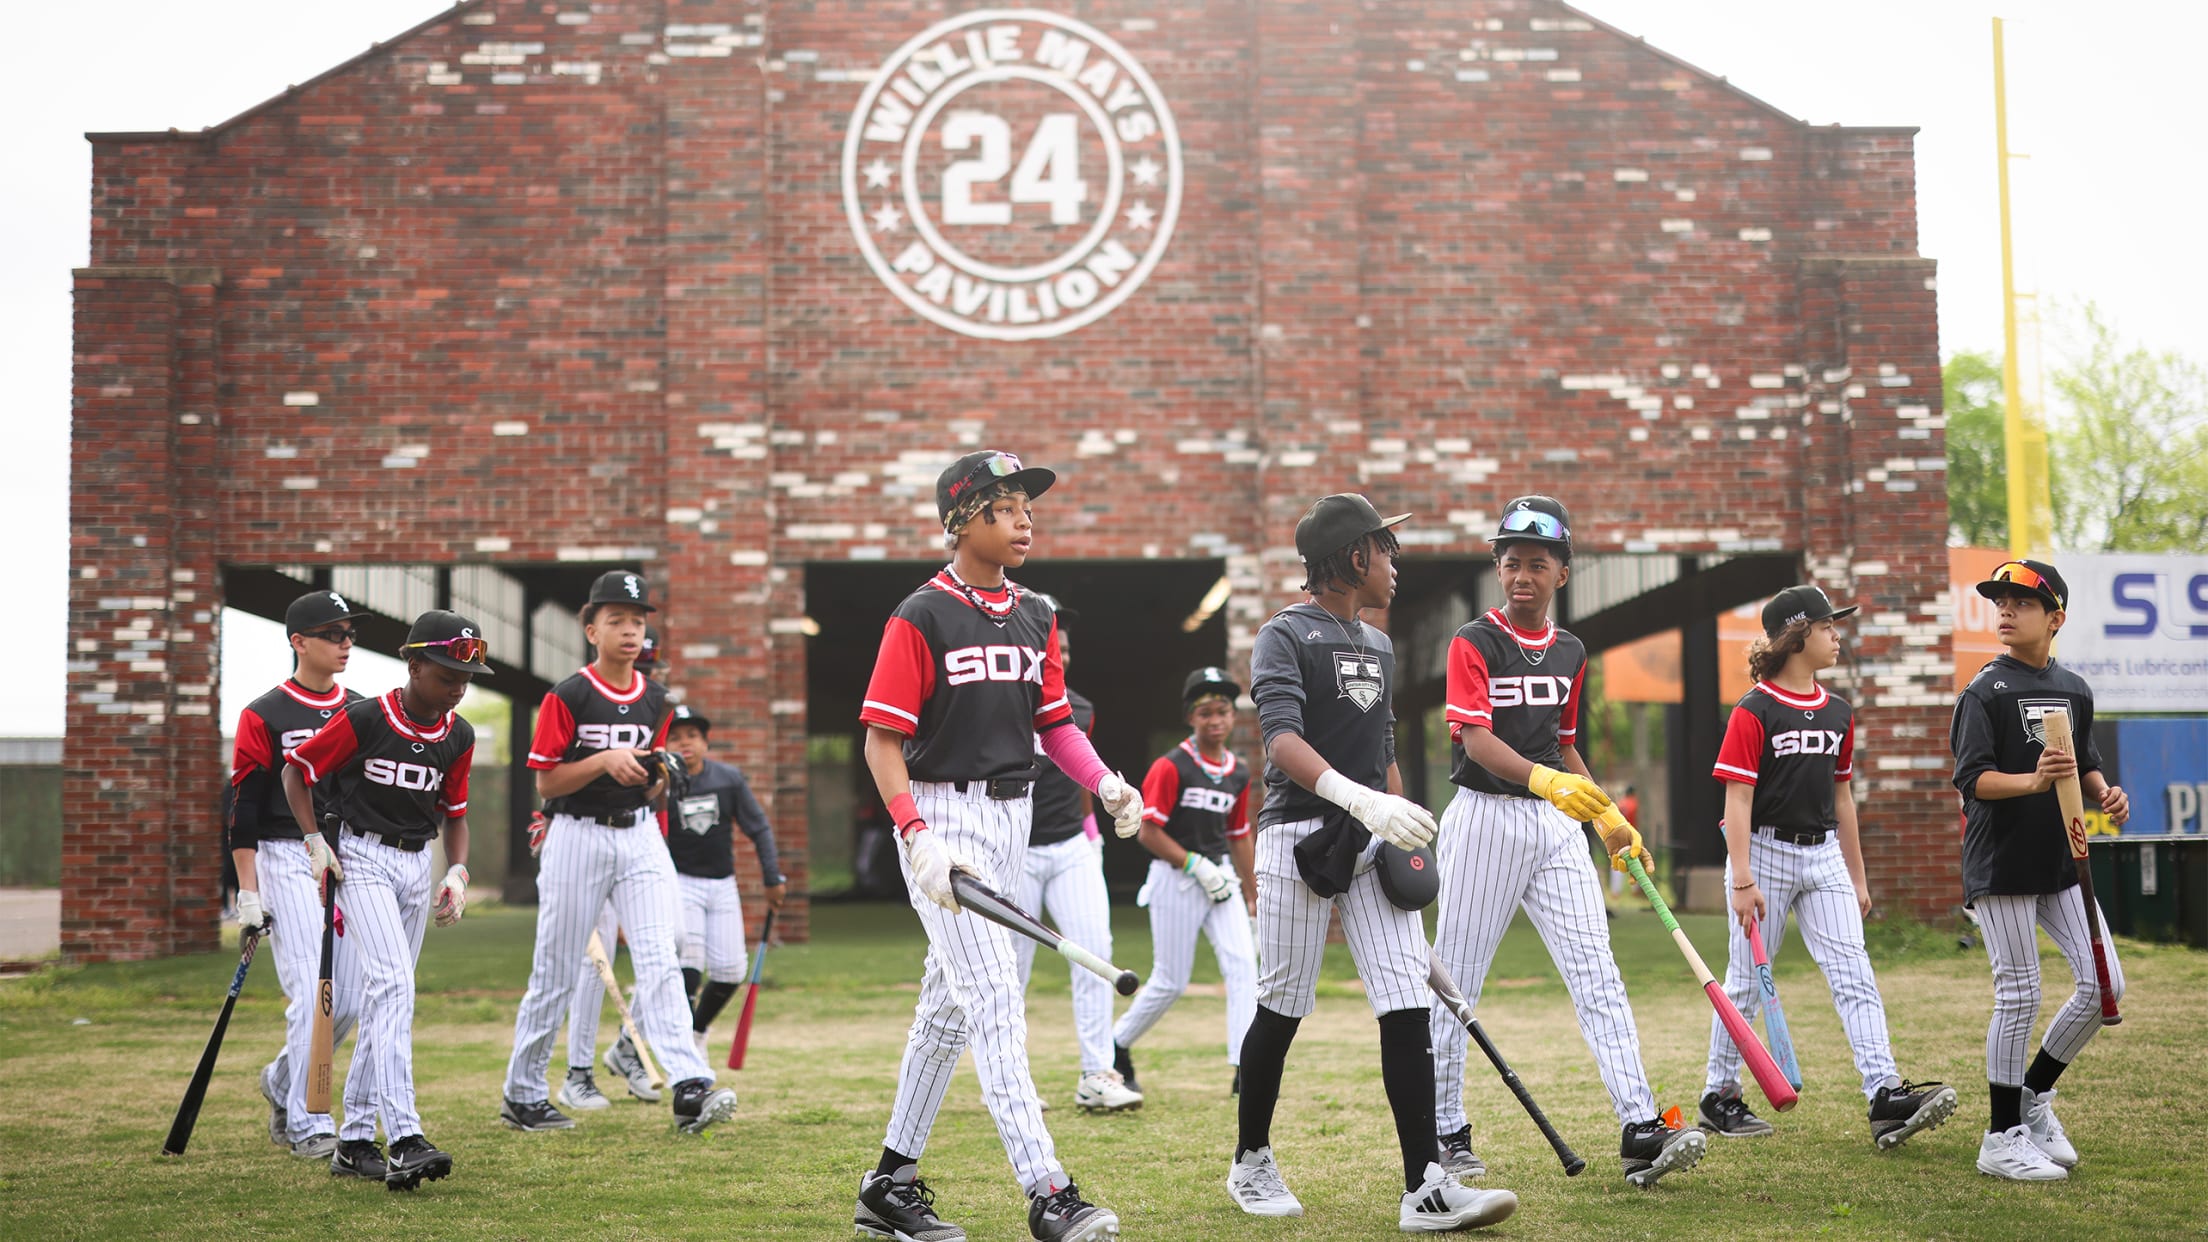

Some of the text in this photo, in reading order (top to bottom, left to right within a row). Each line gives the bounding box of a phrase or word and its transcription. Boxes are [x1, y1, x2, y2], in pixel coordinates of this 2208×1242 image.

[864, 25, 1156, 142] WILLIE MAYS
[941, 113, 1087, 225] 24
[893, 240, 1137, 323] PAVILION
[945, 645, 1047, 686] SOX
[1771, 729, 1845, 758] SOX
[363, 757, 444, 792] SOX
[1180, 786, 1237, 814] SOX
